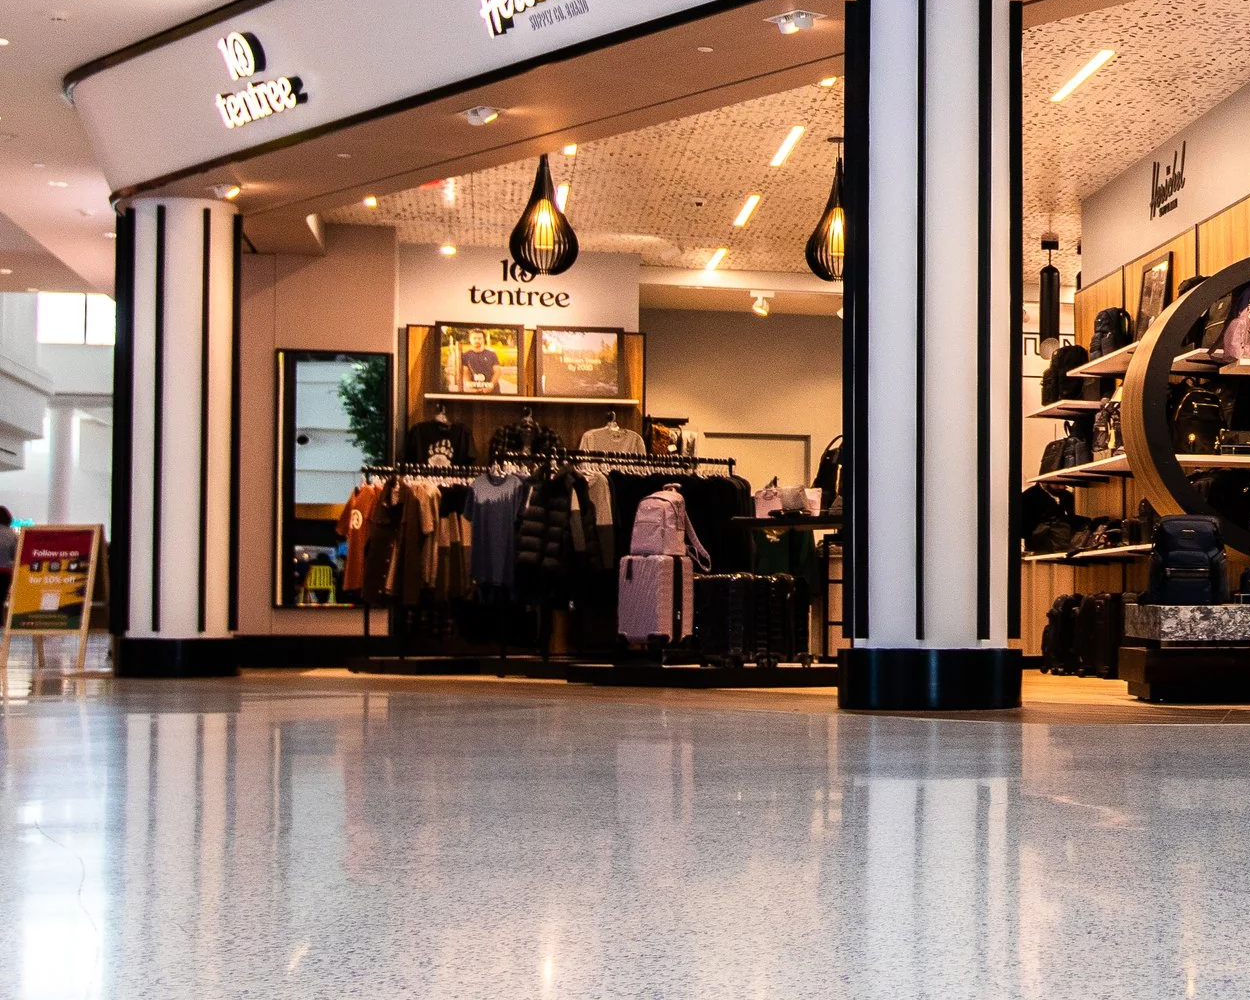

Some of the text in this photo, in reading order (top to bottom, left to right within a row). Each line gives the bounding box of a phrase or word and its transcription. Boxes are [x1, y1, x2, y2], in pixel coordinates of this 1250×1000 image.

[528, 9, 554, 31] SUPPLY
[215, 77, 298, 129] tentree
[468, 285, 571, 308] tentree
[32, 548, 58, 557] Follow
[63, 576, 76, 584] off
